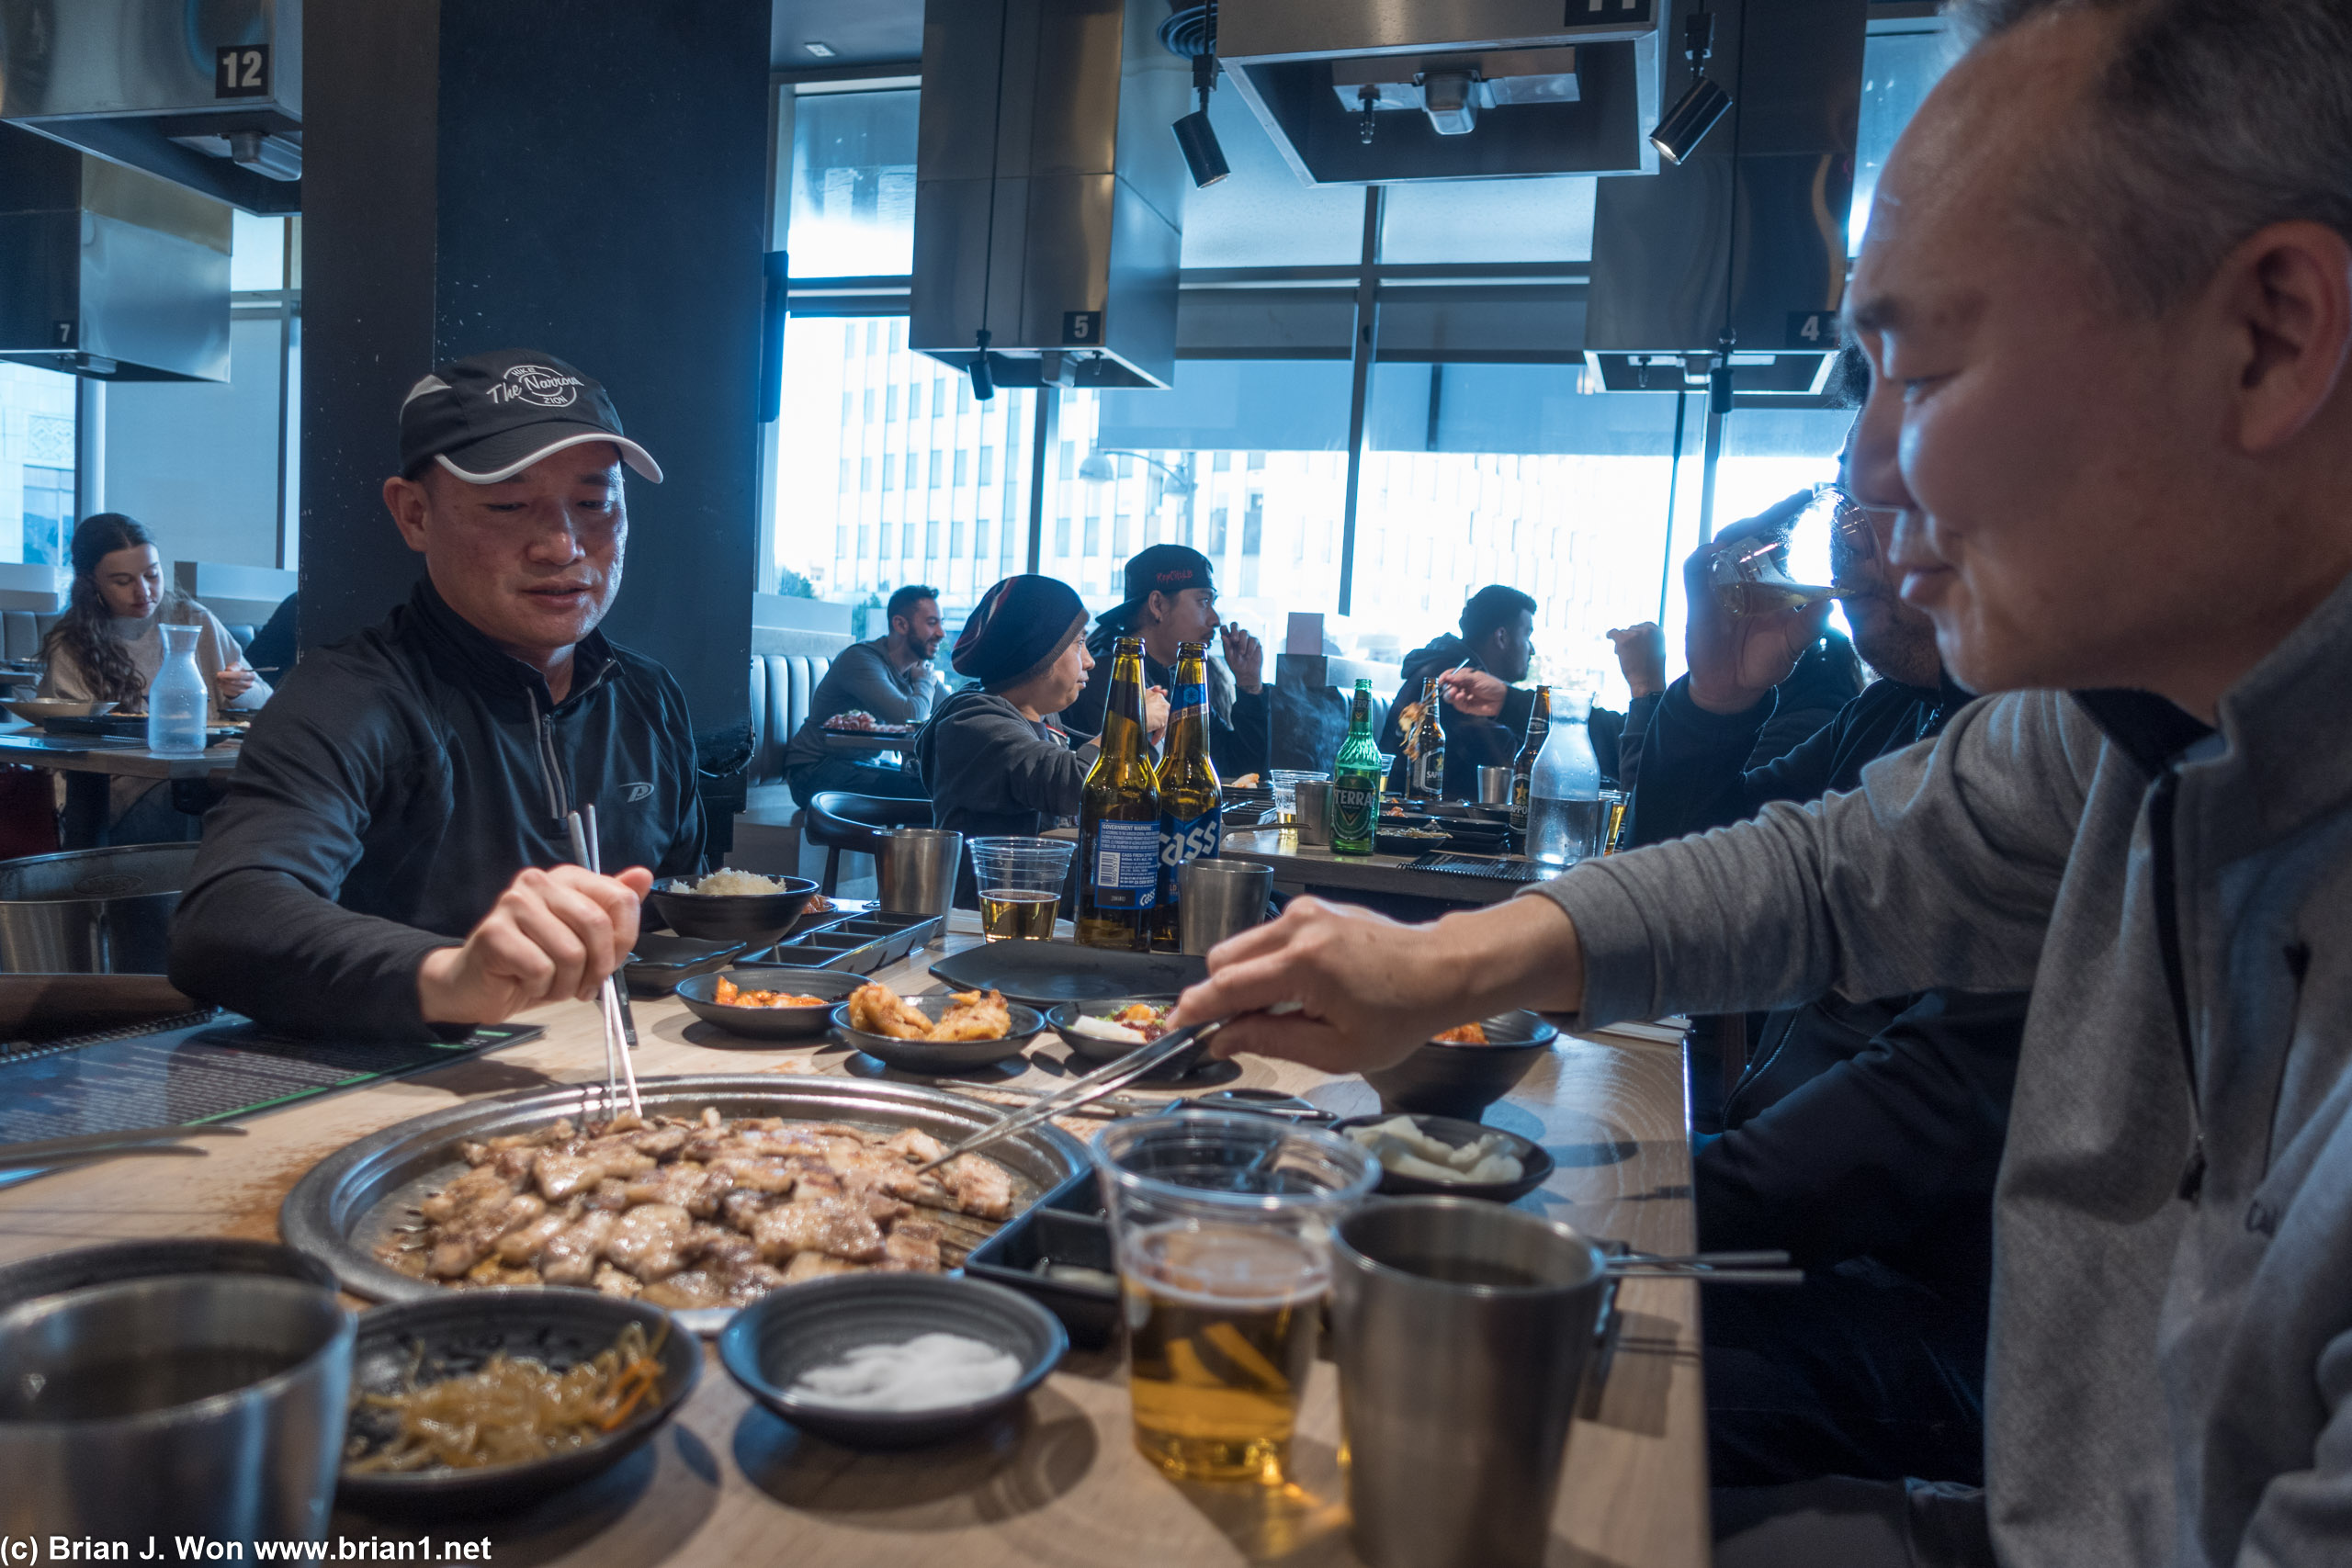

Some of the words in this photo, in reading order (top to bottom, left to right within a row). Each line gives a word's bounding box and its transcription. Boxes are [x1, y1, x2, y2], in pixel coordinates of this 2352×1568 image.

[222, 51, 262, 88] 12
[60, 323, 71, 343] 7
[1074, 315, 1089, 339] 5
[1801, 315, 1820, 342] 4
[511, 367, 537, 378] HIKE
[486, 381, 522, 404] The
[543, 395, 568, 405] ZION
[1335, 789, 1373, 808] TERRA
[1102, 823, 1134, 831] GOVERNMENT
